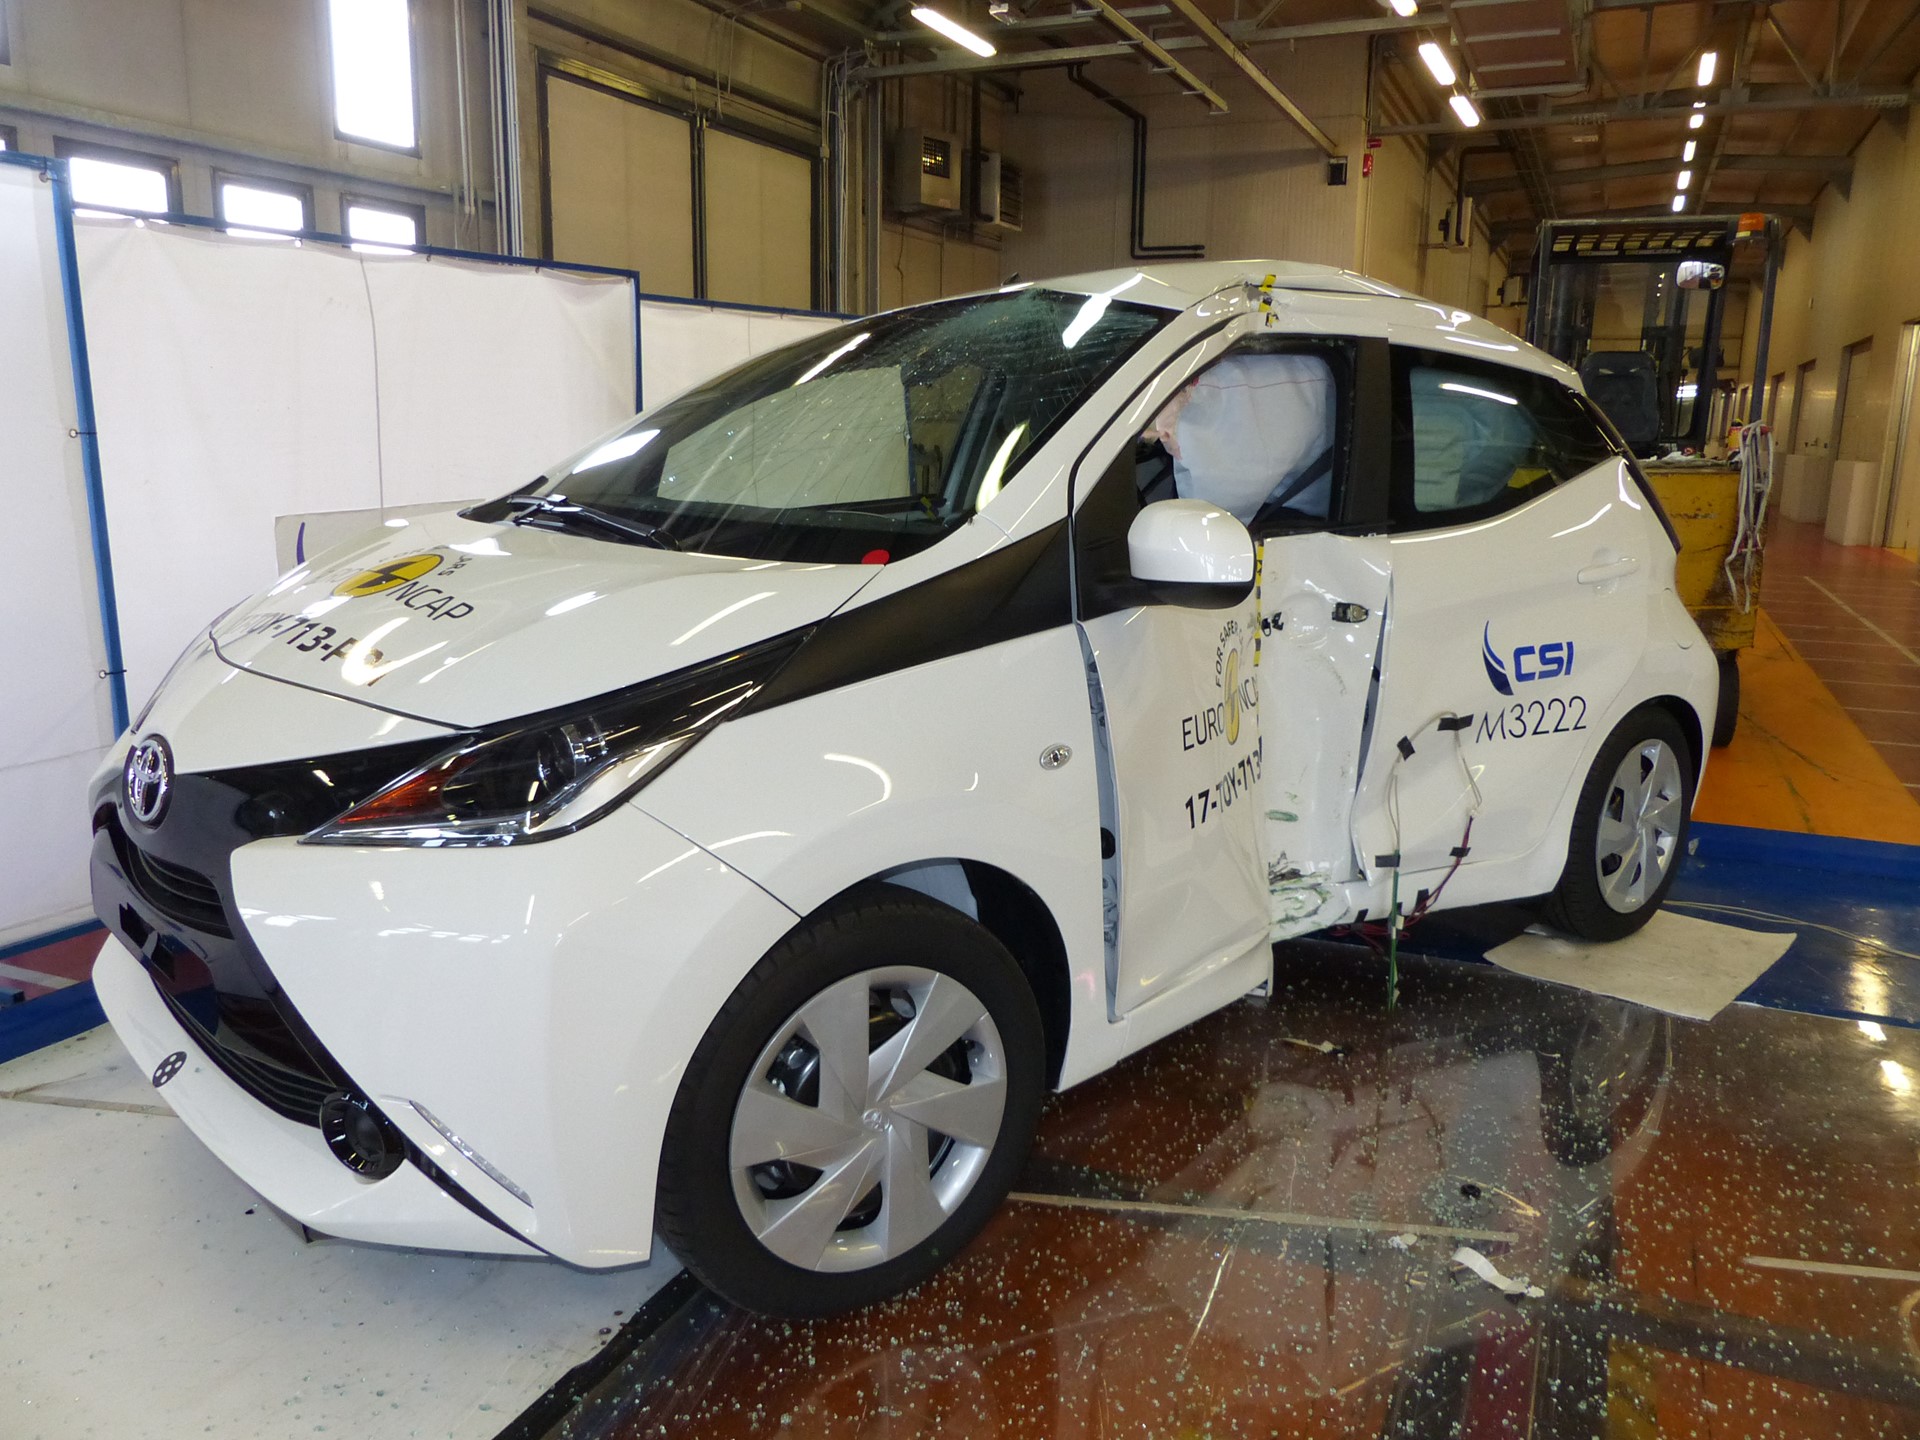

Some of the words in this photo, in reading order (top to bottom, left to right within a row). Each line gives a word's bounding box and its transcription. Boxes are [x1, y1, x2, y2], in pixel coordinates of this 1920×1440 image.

[385, 581, 475, 622] NCAP
[1215, 646, 1225, 689] FOR
[1513, 641, 1574, 682] CSI
[1182, 702, 1226, 751] EURO
[1475, 696, 1587, 744] M3222
